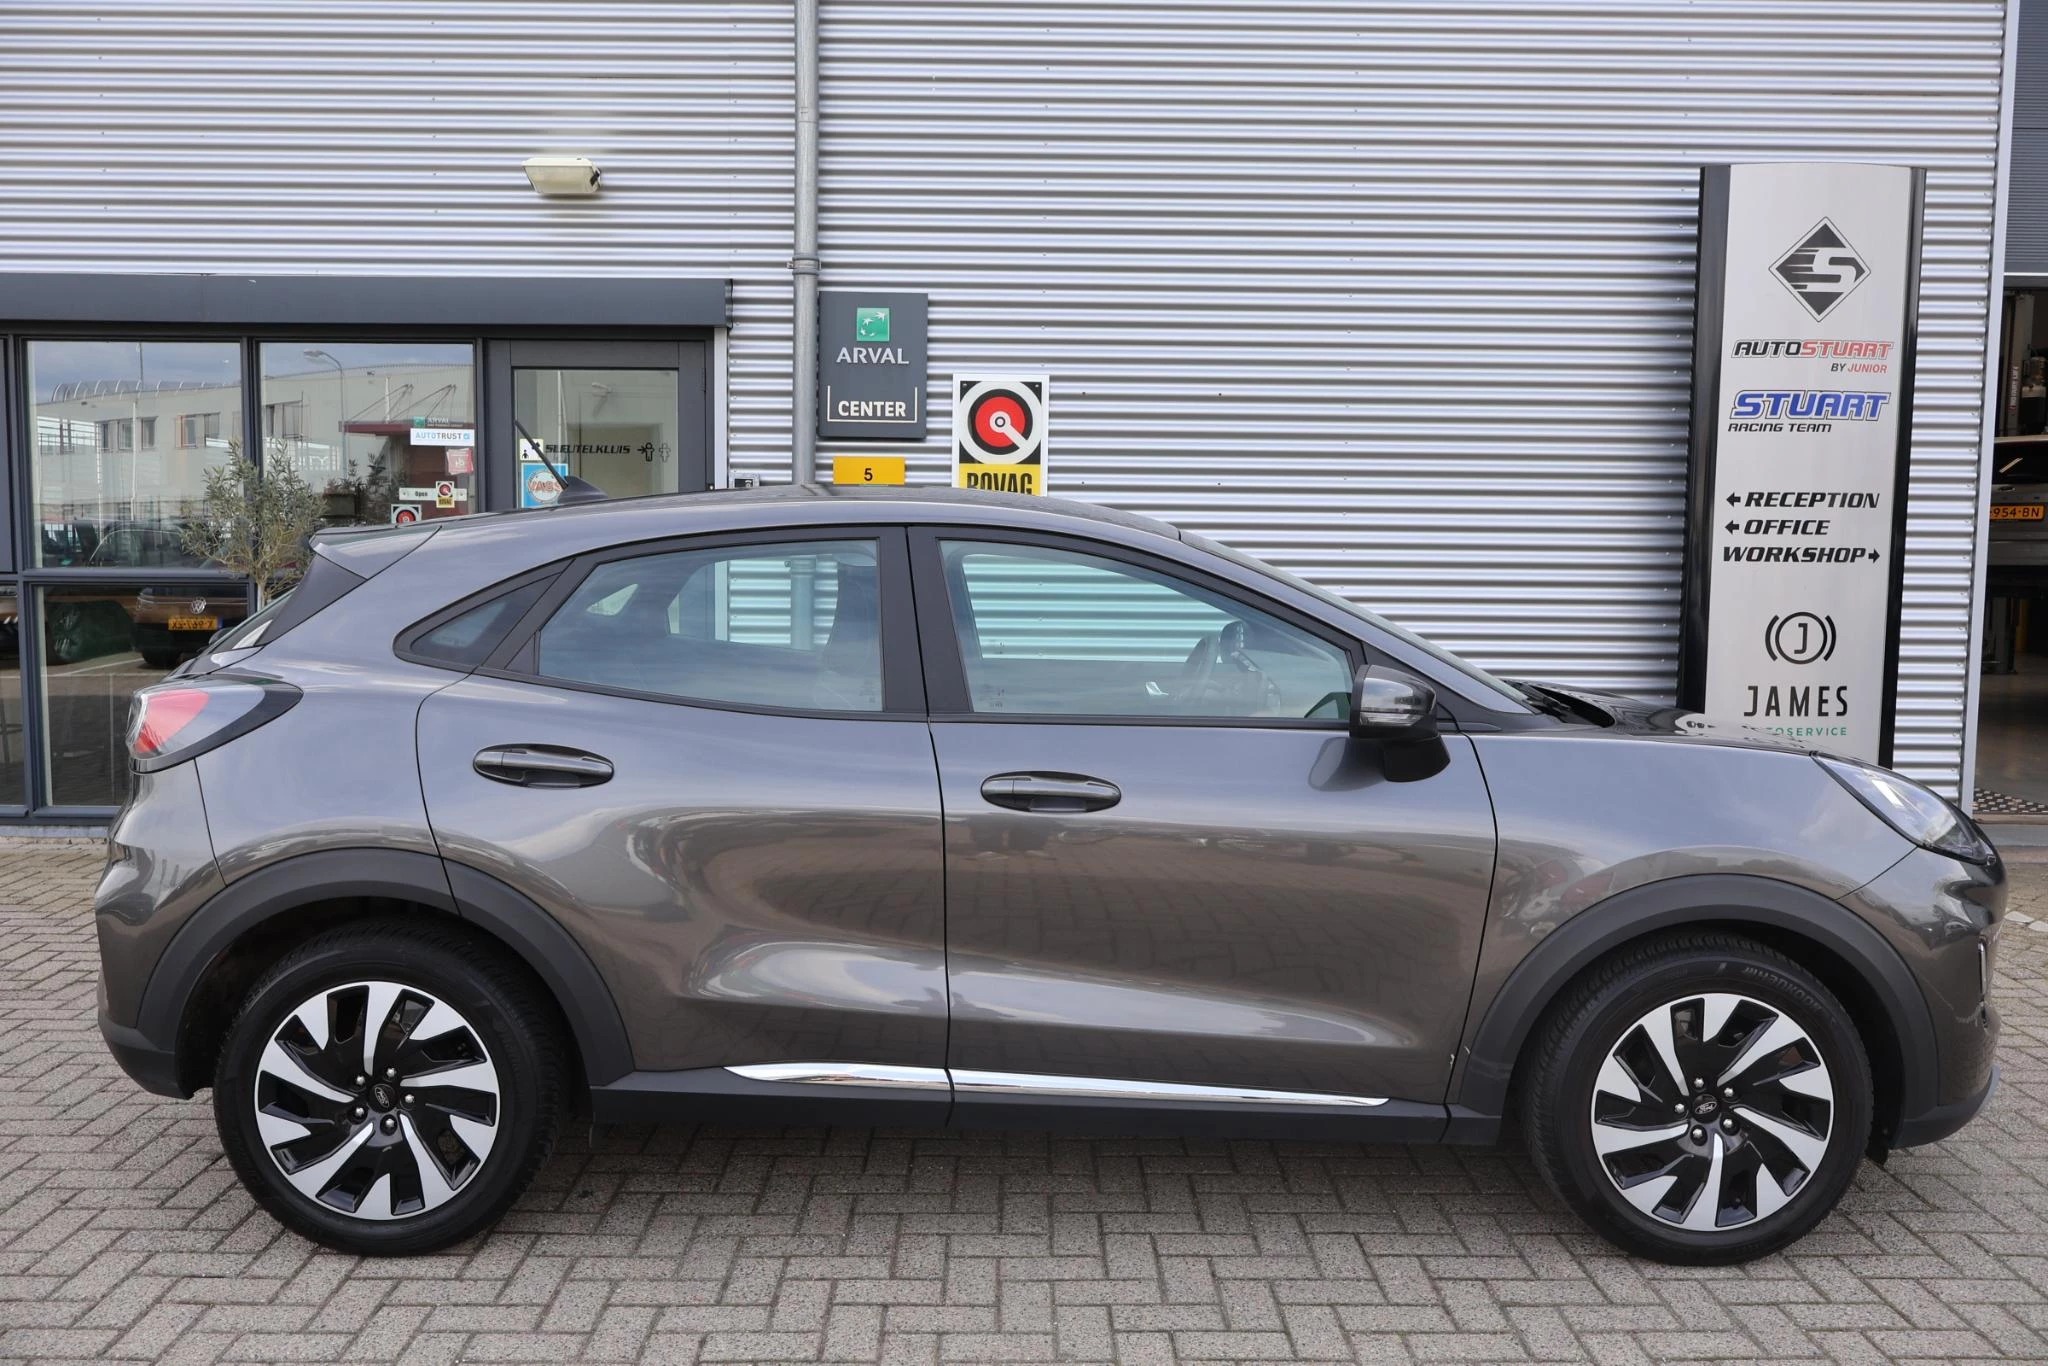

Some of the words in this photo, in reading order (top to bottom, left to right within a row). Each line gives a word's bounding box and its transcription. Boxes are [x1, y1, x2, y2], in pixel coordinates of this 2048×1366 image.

[836, 347, 909, 365] ARVAL
[1831, 363, 1845, 373] BY
[1848, 364, 1887, 374] JUNIOR
[838, 400, 906, 417] CENTER
[1731, 391, 1890, 420] STUART
[415, 432, 462, 440] AUTOTRUST
[1728, 424, 1783, 433] RACING
[1788, 424, 1832, 433] TEAM
[863, 467, 873, 482] 5
[1744, 492, 1880, 509] RECEPTION
[1744, 519, 1830, 535] OFFICE
[1723, 547, 1866, 563] WORKSHOP
[1743, 685, 1848, 717] JAMES
[1766, 727, 1847, 736] OSERVICE
